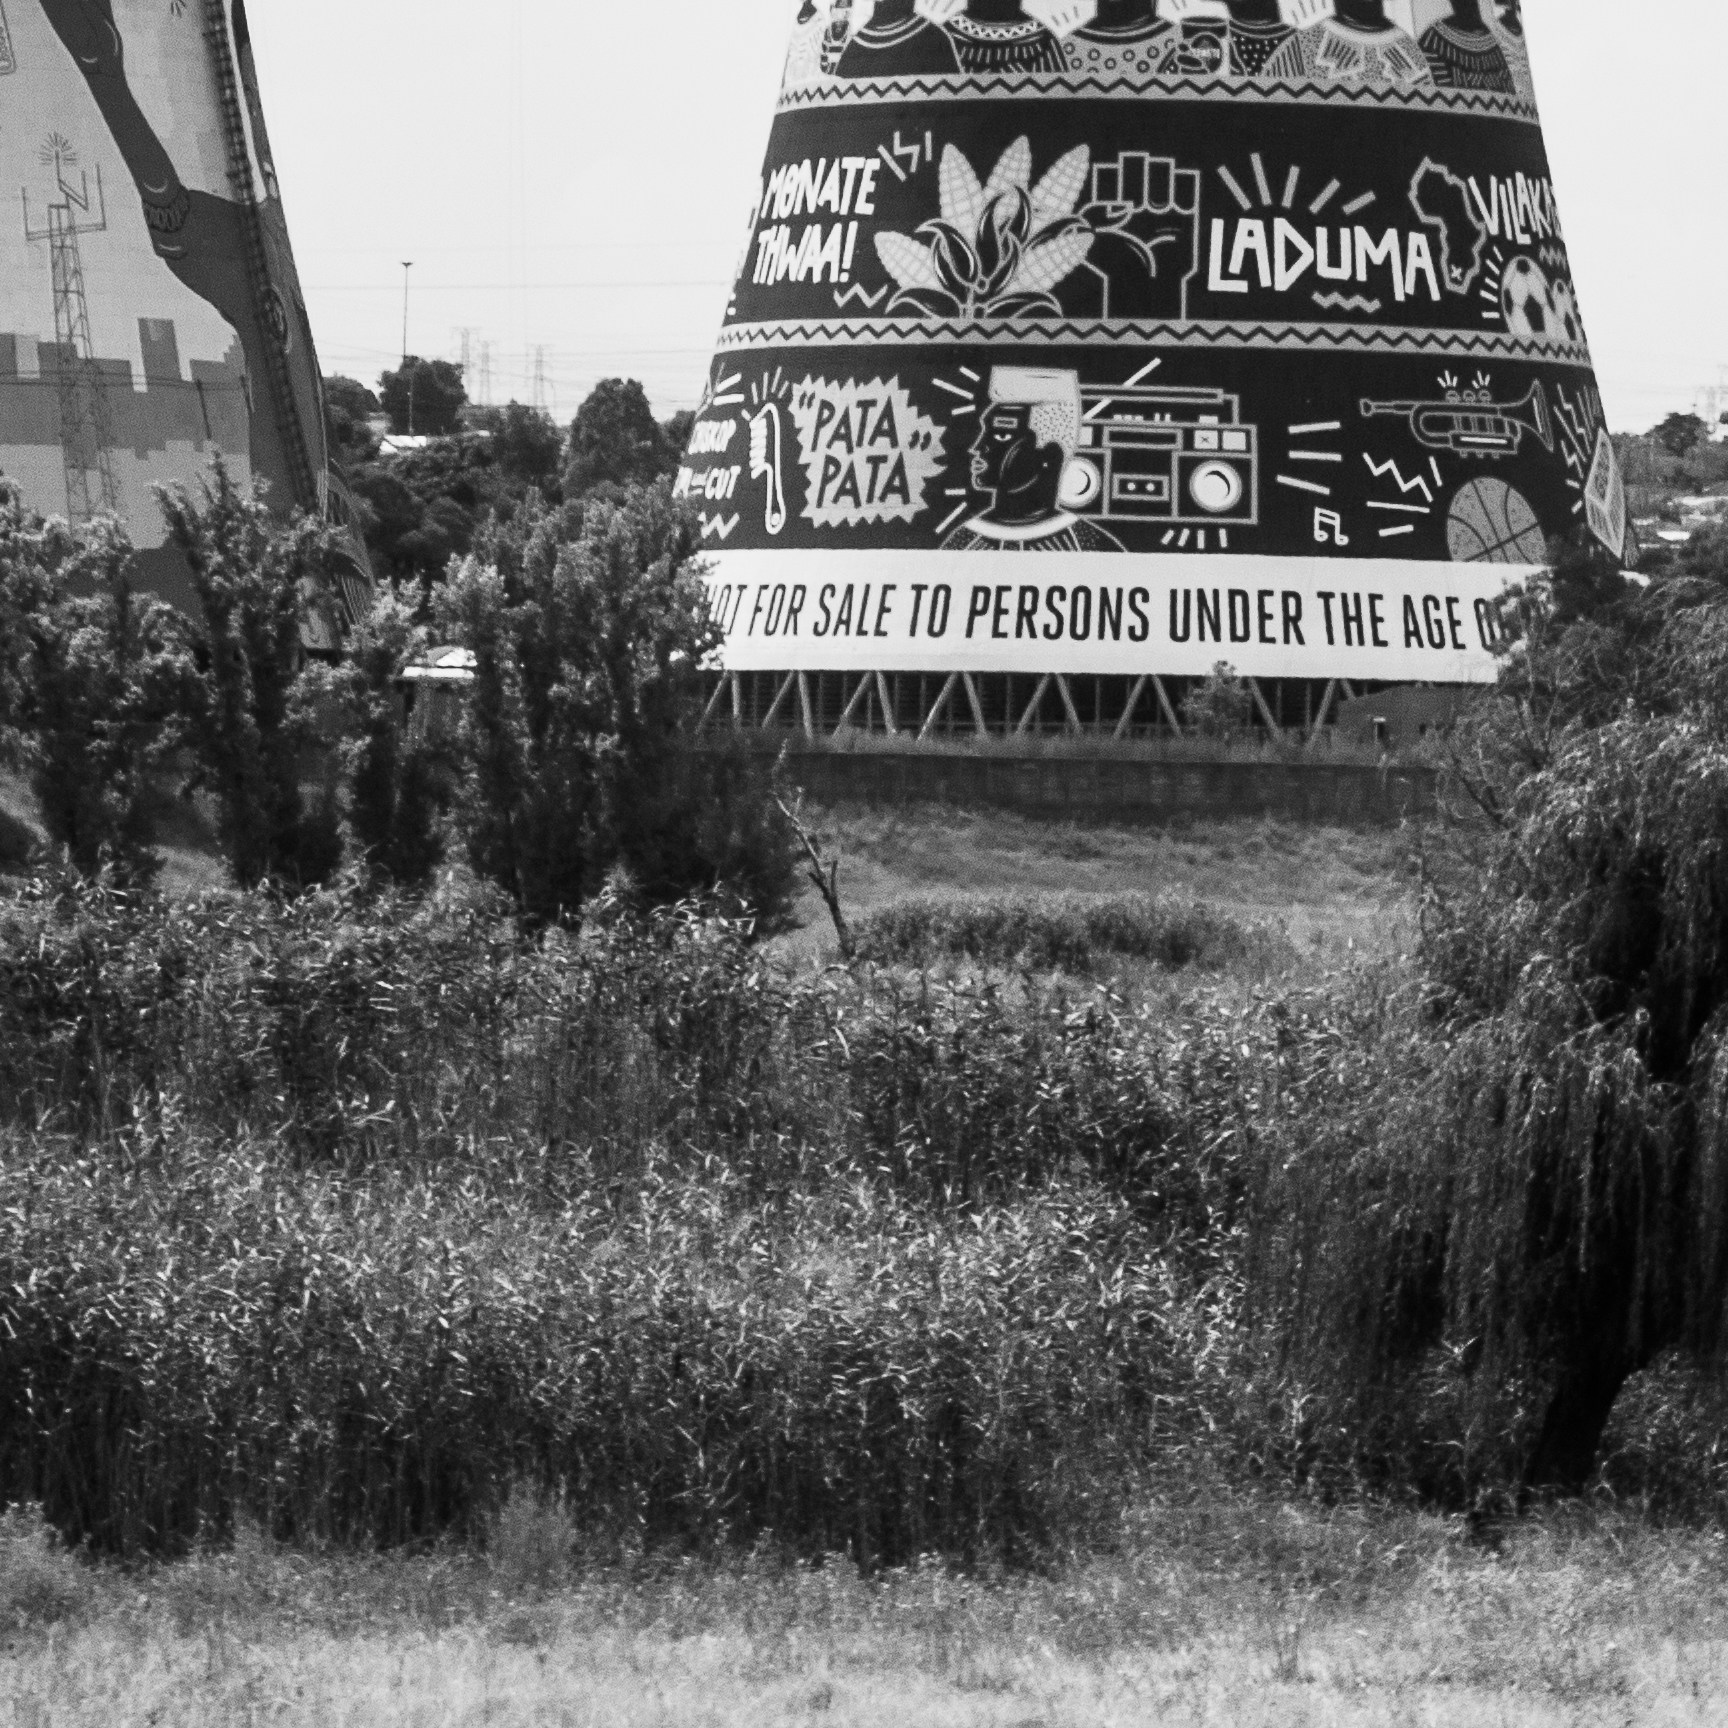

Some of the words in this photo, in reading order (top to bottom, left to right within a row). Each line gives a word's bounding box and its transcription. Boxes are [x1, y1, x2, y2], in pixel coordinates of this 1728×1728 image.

[760, 155, 881, 220] MONATE
[752, 220, 859, 286] THWAA!
[1207, 216, 1441, 302] LADUMA
[748, 584, 807, 636] FOR
[812, 583, 897, 637] SALE
[908, 583, 952, 638] TO
[965, 585, 1150, 643] PERSONS
[1168, 588, 1306, 646] UNDER
[1316, 591, 1389, 648] THE
[1403, 594, 1467, 650] AGE
